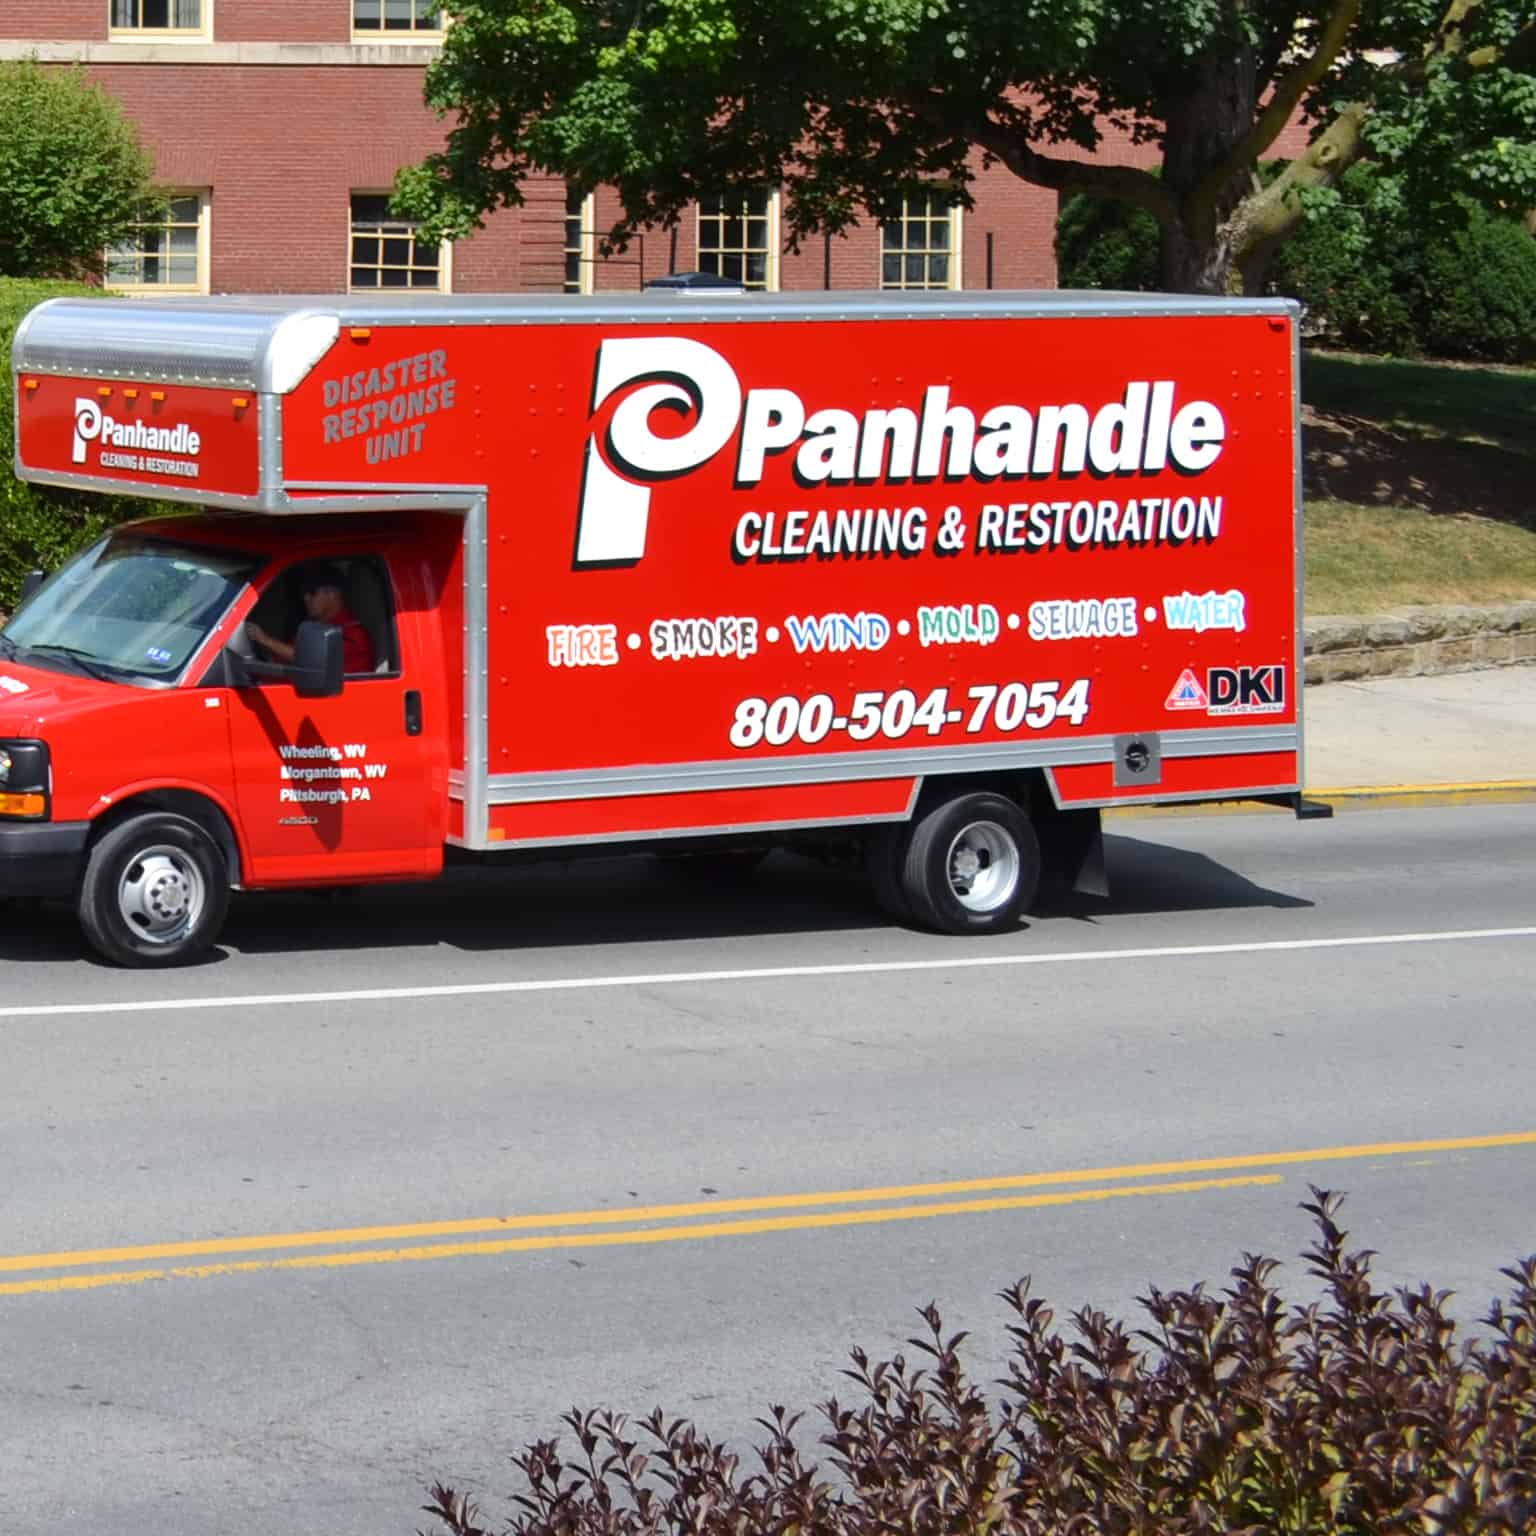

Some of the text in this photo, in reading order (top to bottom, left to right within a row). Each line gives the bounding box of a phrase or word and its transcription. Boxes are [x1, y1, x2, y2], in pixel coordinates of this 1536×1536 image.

[323, 349, 447, 408] DISASTER
[100, 415, 201, 455] Panhandle
[323, 379, 457, 444] RESPONSE
[735, 379, 1226, 483] Panhandle
[365, 423, 427, 465] UNIT
[735, 495, 1223, 558] CLEANING & RESTORATION
[545, 589, 1246, 668] FIRE SMOKE WIND MOLD SEWAGE WATER
[1209, 667, 1284, 705] DKI
[729, 679, 1092, 748] 800-504-7054
[279, 743, 367, 761] Wheeling, WV
[280, 763, 388, 782] Morgantown, WV
[279, 786, 371, 804] Pittsburgh, PA
